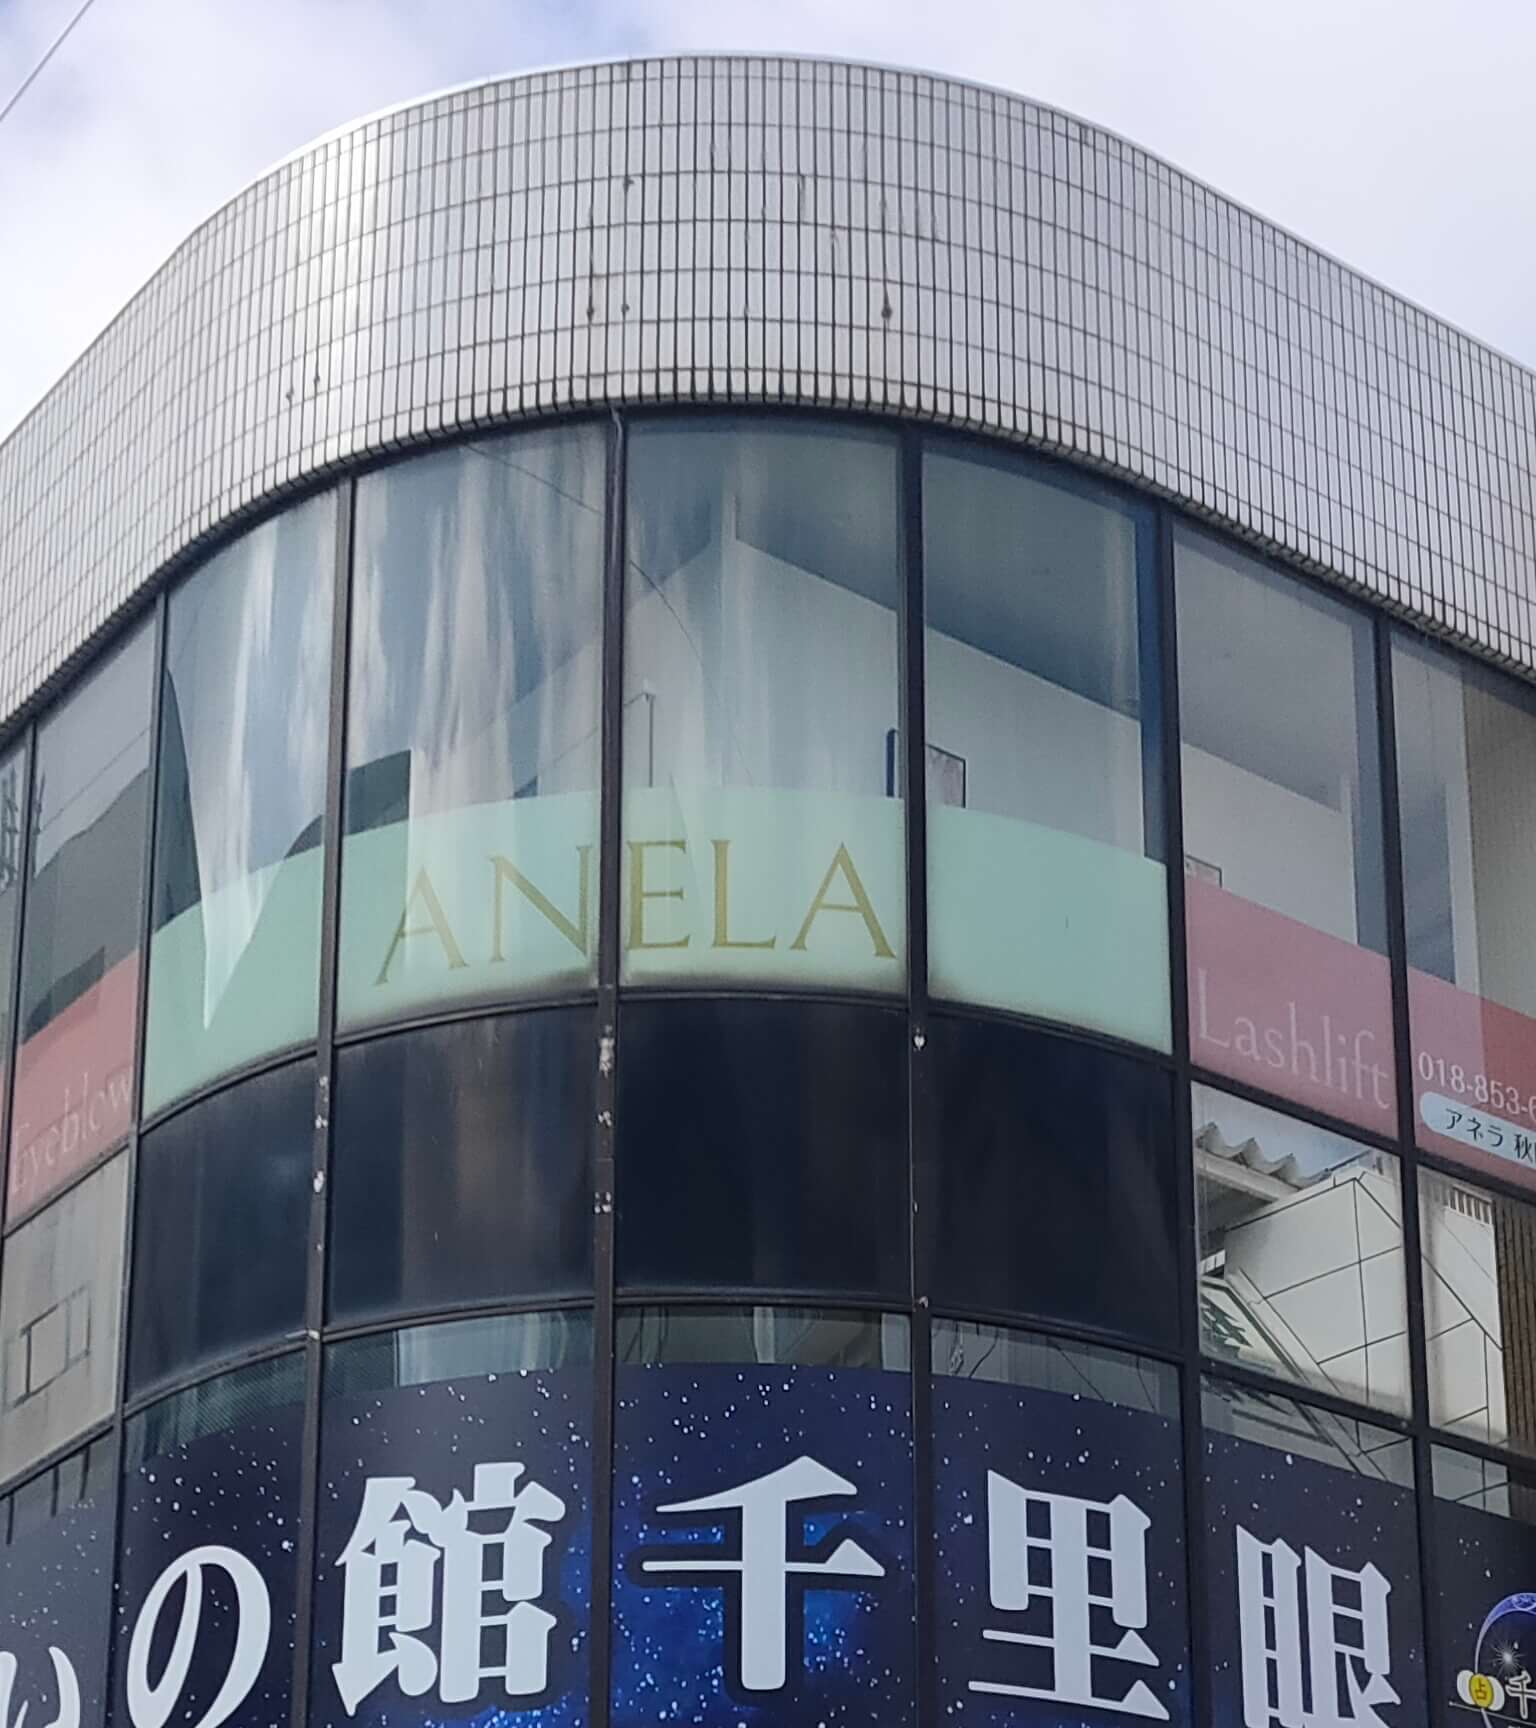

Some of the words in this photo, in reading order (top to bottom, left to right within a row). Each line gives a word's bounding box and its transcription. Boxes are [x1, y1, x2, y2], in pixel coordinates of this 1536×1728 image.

[375, 840, 897, 986] ANELA
[1198, 968, 1390, 1109] Lashlift
[1445, 1108, 1504, 1148] アネラ
